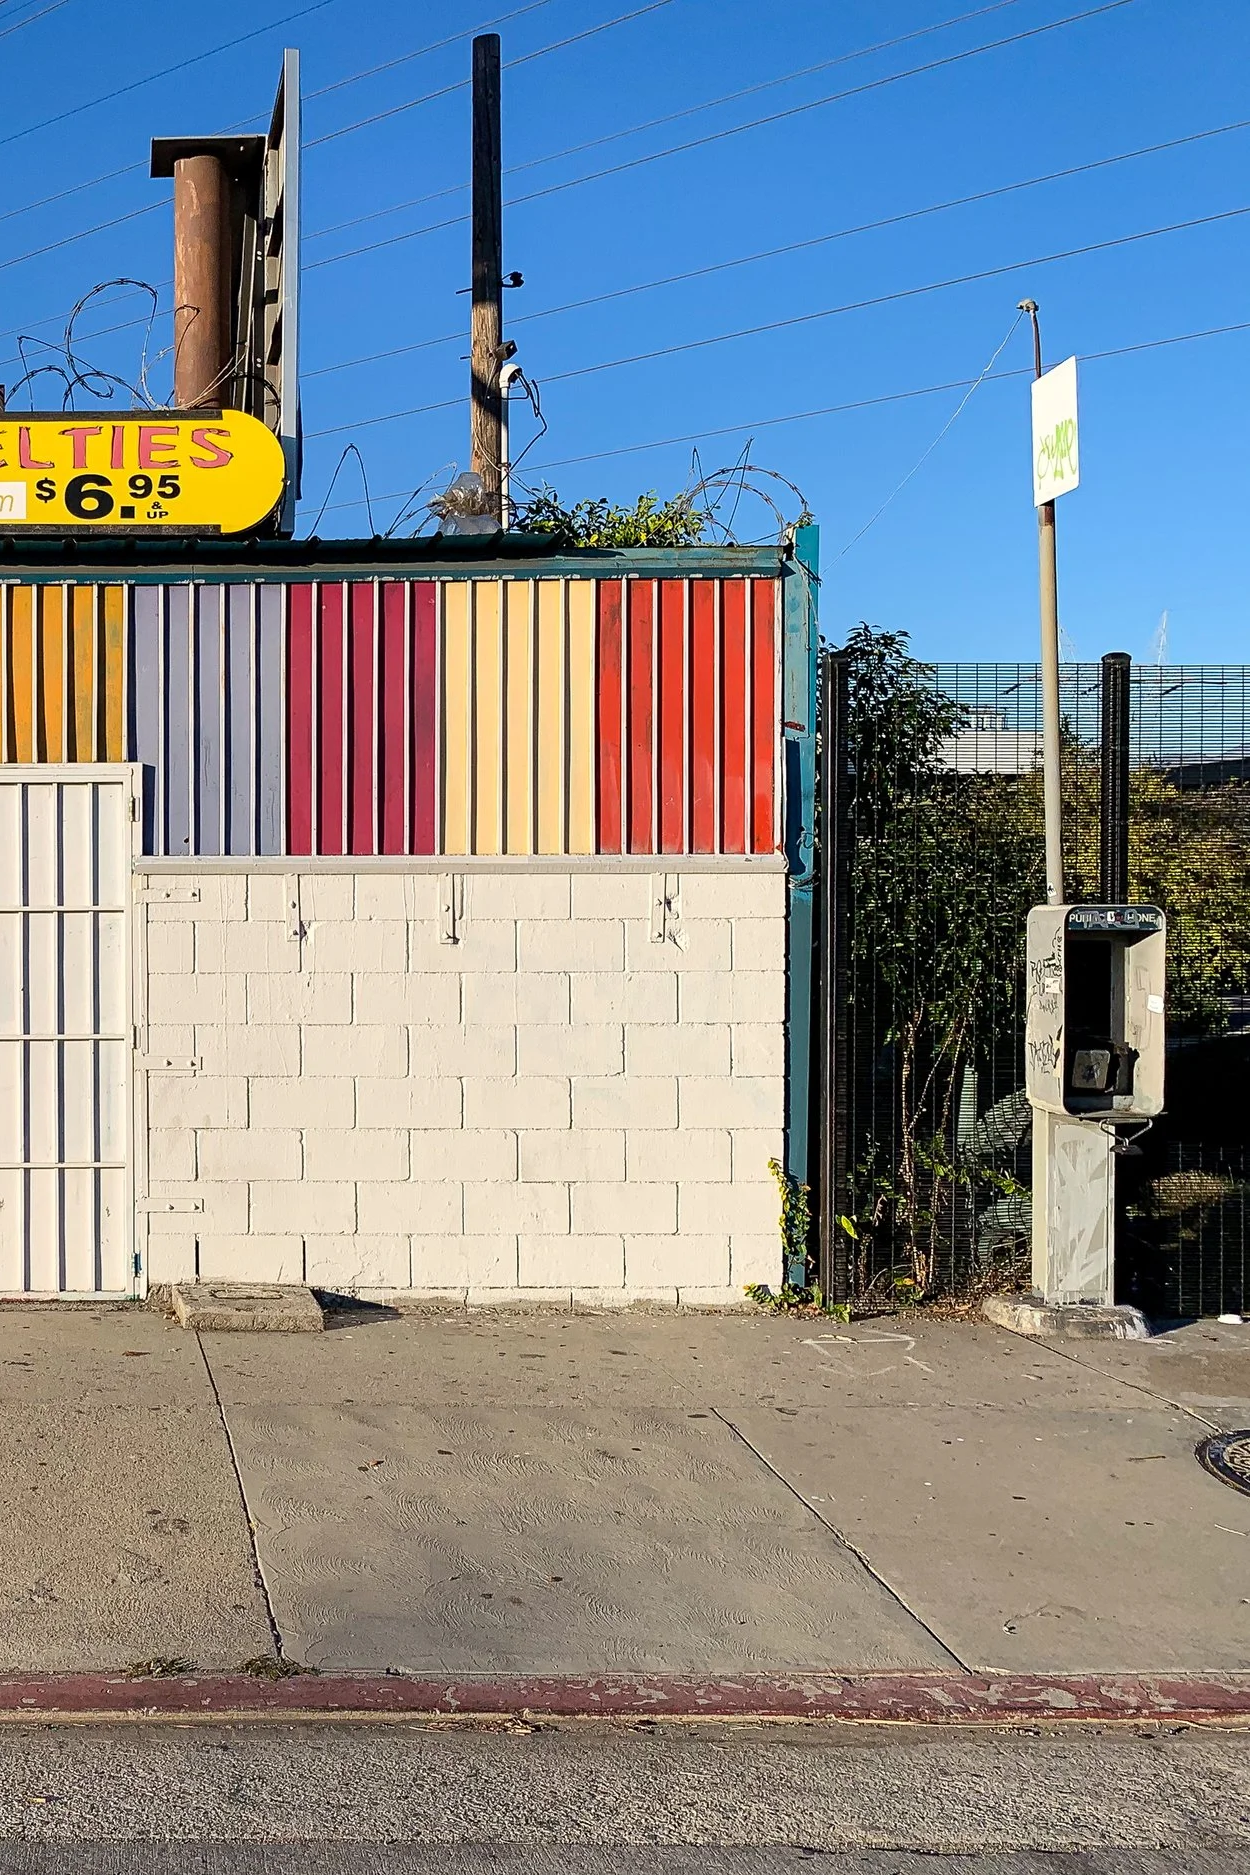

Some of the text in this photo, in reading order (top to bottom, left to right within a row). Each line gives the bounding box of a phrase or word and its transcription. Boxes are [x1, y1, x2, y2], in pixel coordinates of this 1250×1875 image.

[151, 501, 162, 510] &
[146, 511, 169, 519] UP
[1120, 913, 1156, 922] HONE
